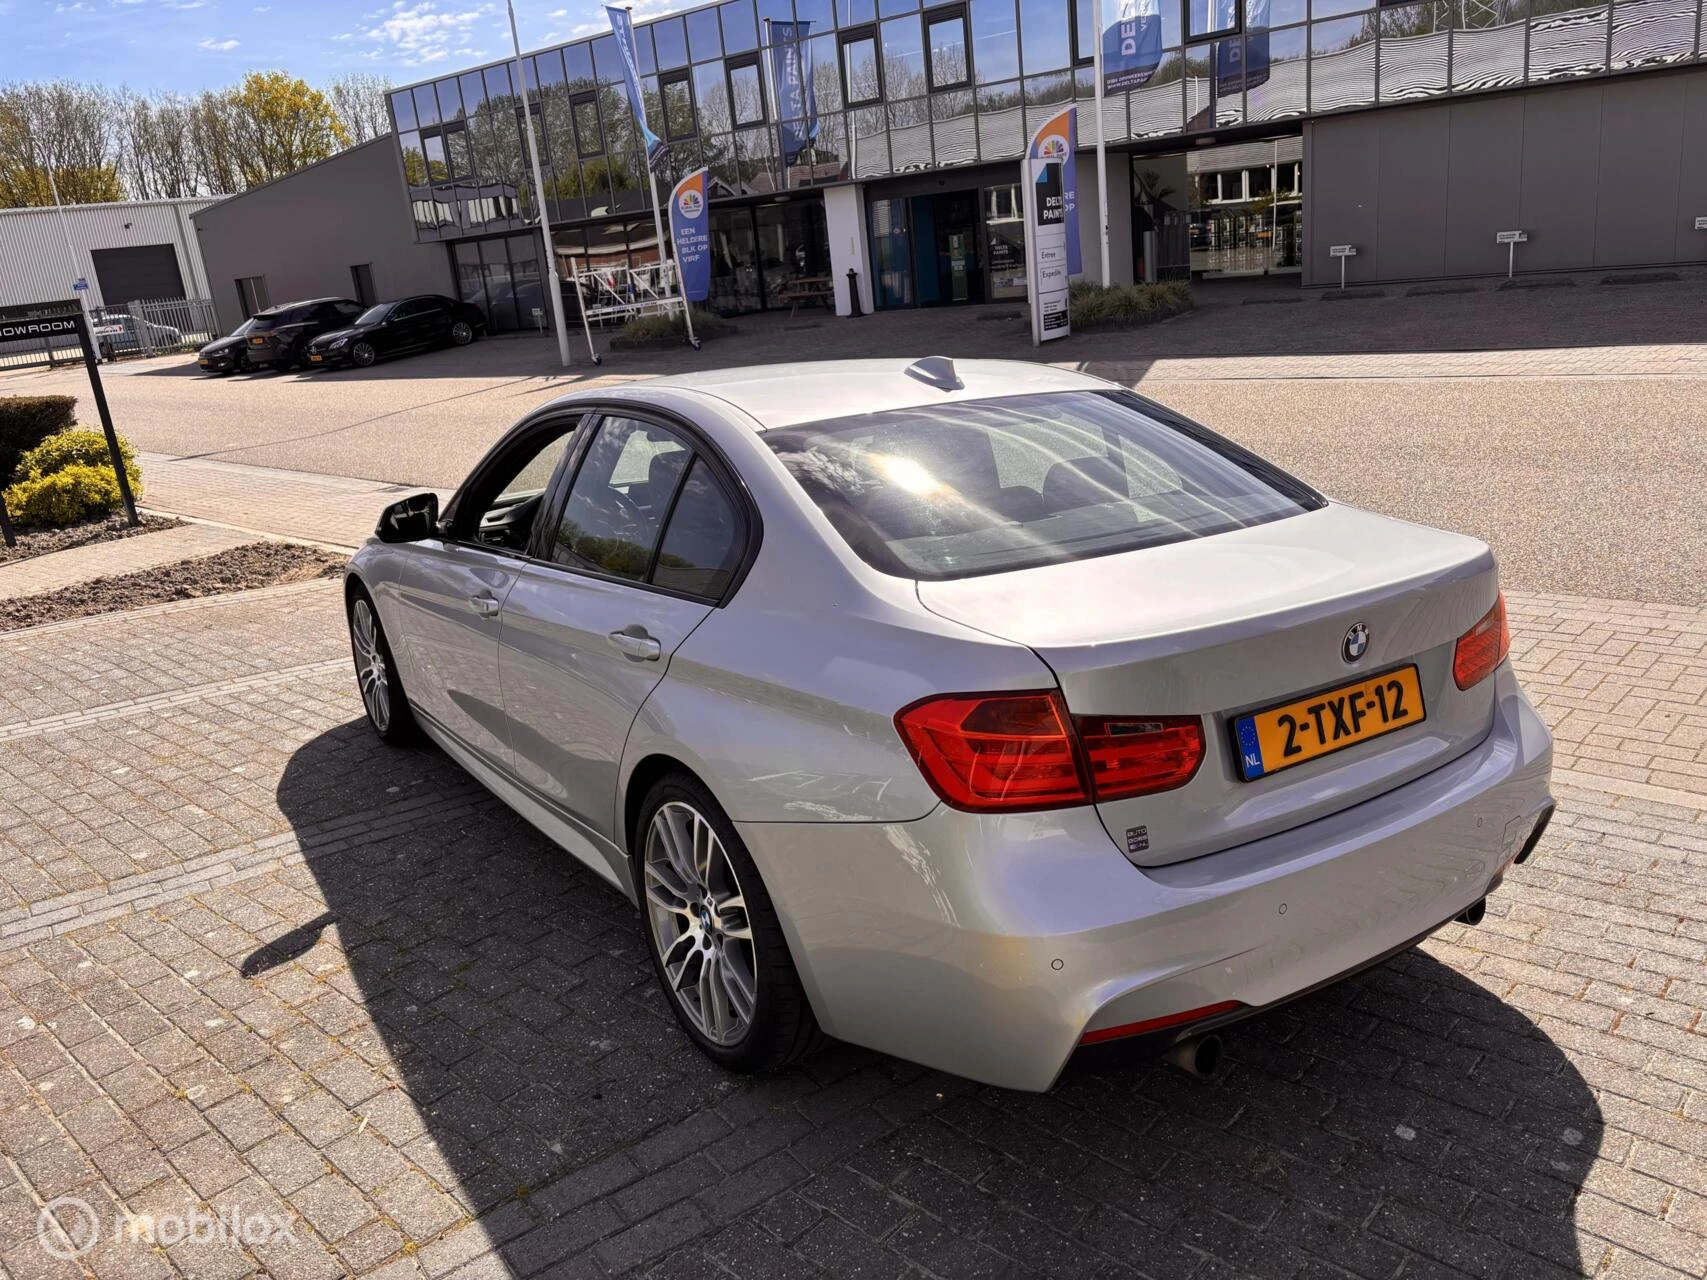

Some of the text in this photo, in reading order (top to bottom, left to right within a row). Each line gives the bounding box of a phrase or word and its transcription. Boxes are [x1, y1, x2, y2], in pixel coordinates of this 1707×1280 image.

[1043, 208, 1063, 220] PAINT
[0, 320, 75, 337] OWROOM
[1277, 679, 1409, 758] 2-TXF-12
[1245, 753, 1261, 768] NL
